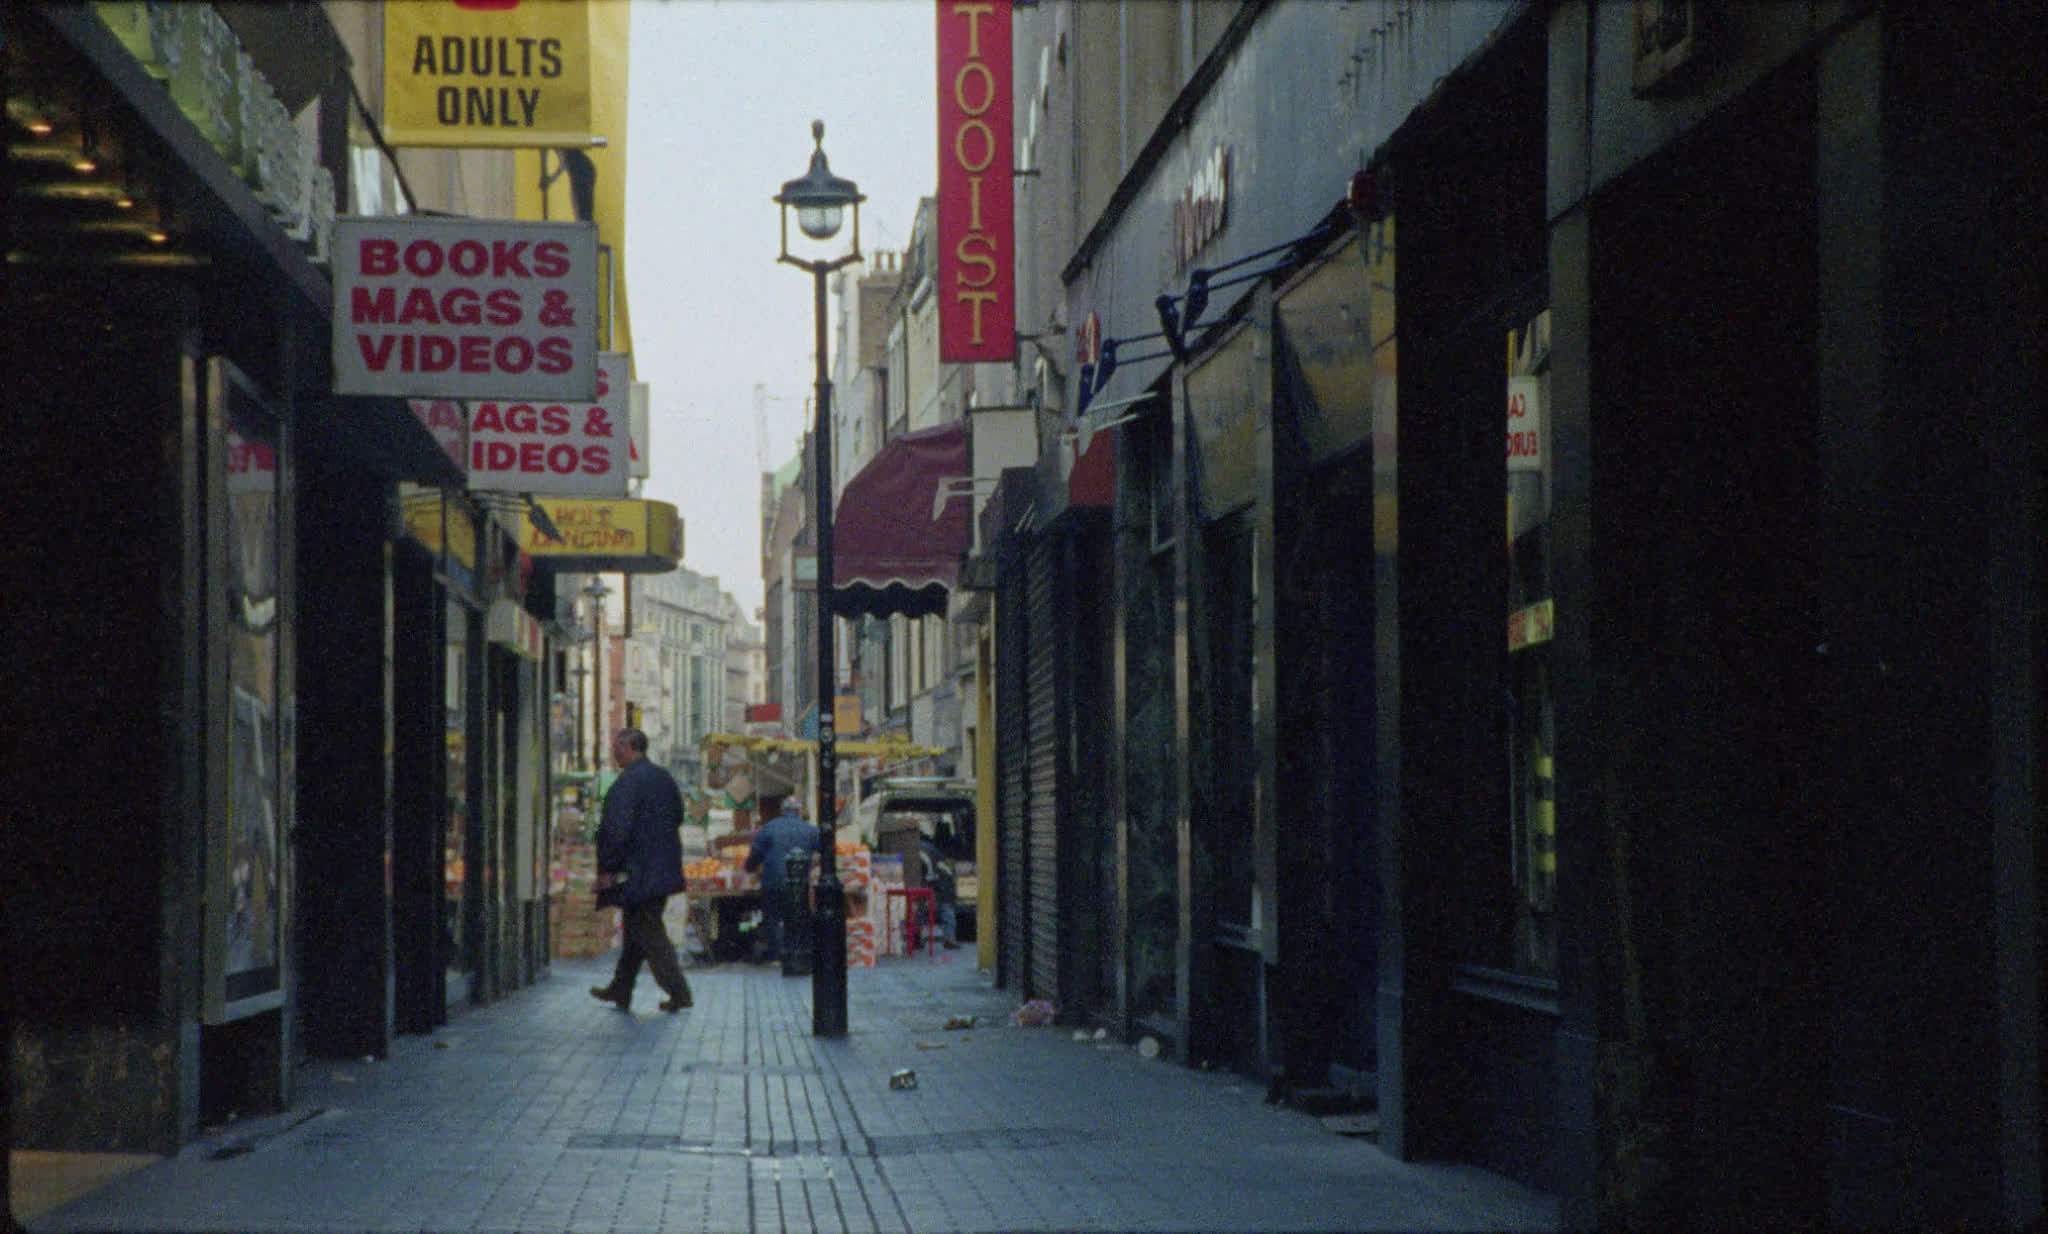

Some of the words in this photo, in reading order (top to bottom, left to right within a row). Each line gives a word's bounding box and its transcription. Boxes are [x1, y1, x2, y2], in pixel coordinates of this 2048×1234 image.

[413, 35, 562, 79] ADULTS
[437, 86, 541, 128] ONLY
[359, 239, 571, 277] BOOKS
[351, 287, 522, 325] MAGS
[539, 289, 576, 326] &
[359, 334, 574, 374] VIDEOS
[471, 403, 571, 436] AGS
[583, 406, 613, 437] &
[471, 441, 612, 475] IDEOS
